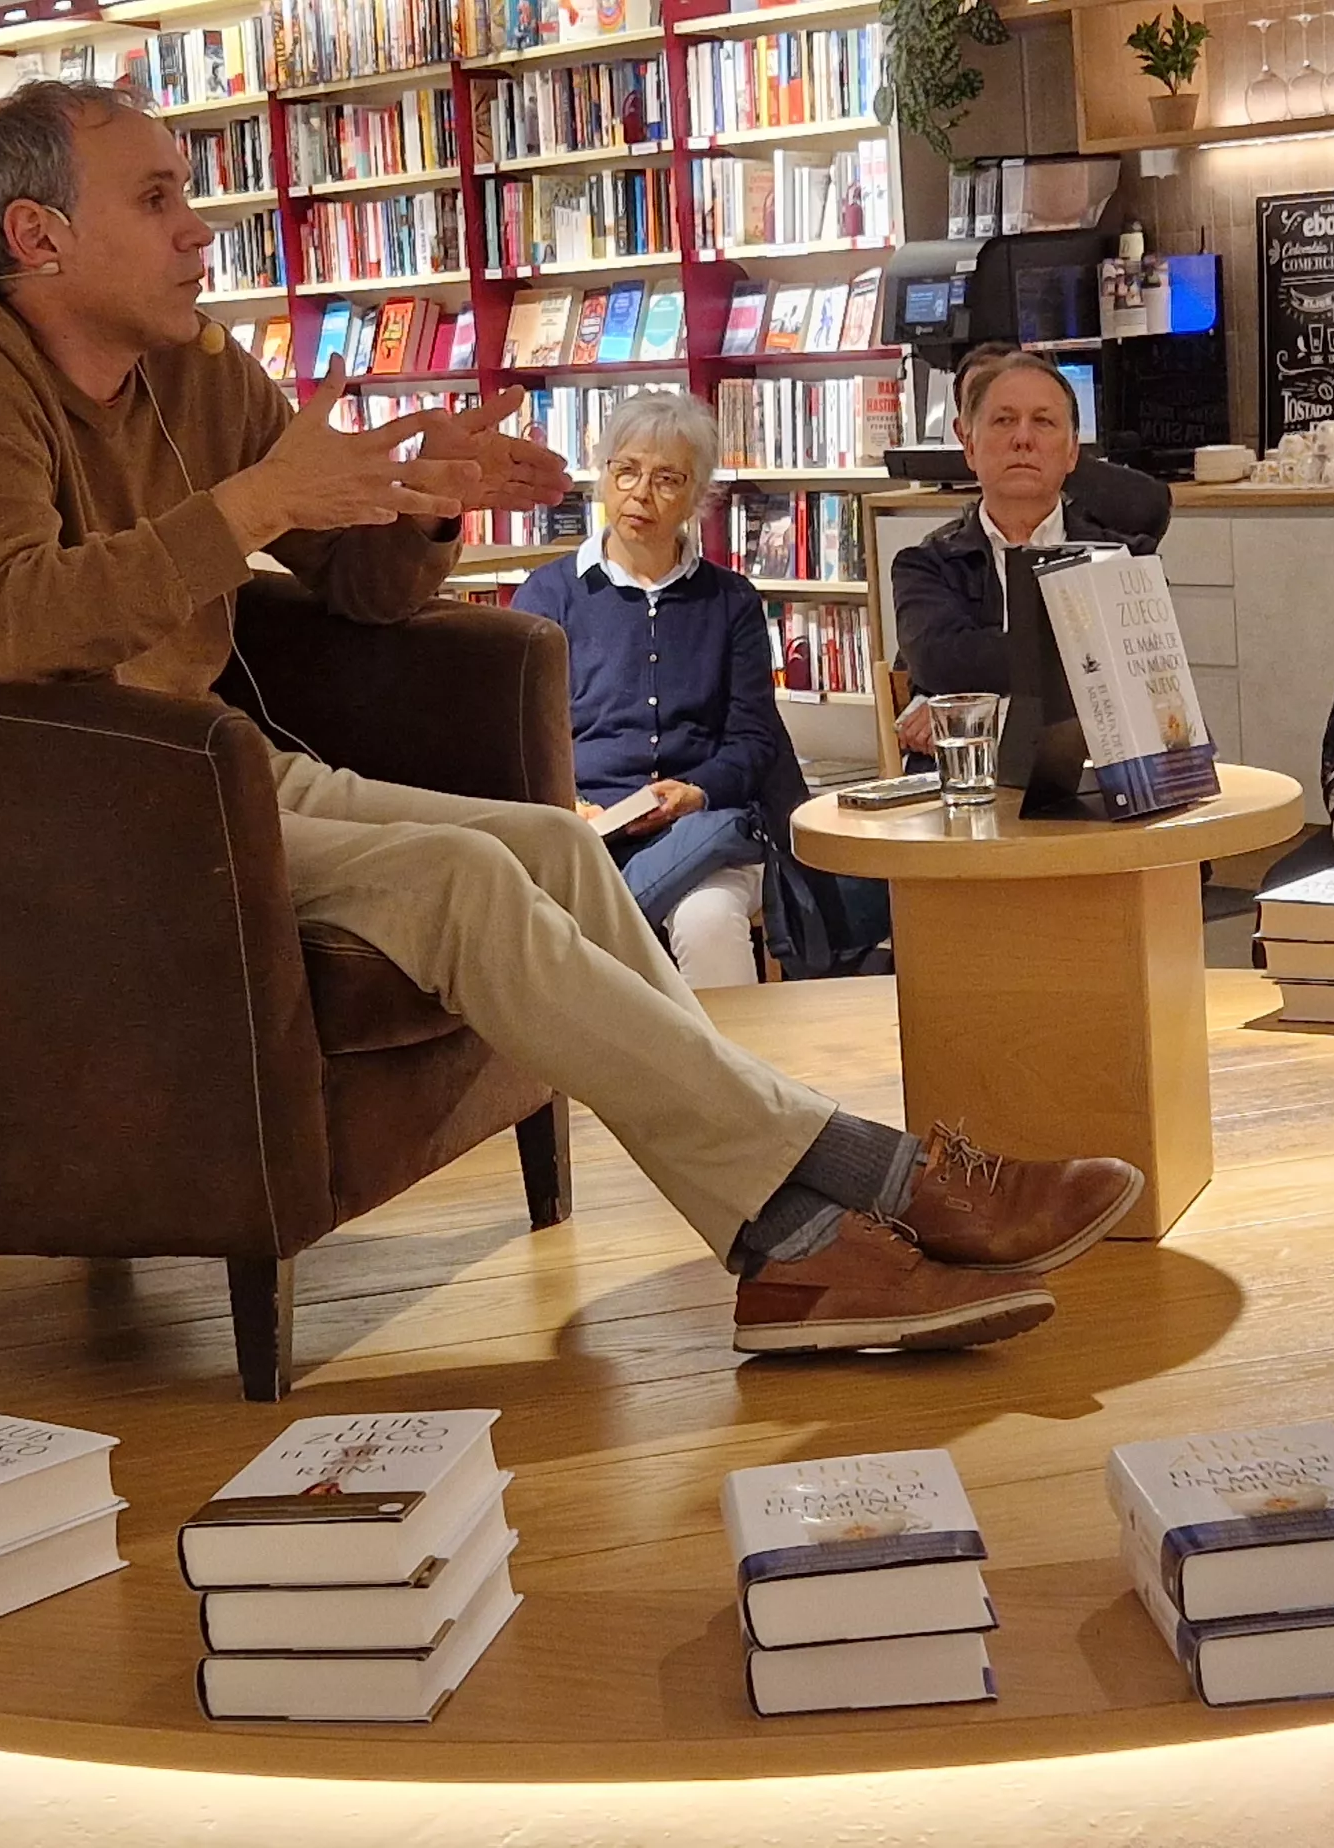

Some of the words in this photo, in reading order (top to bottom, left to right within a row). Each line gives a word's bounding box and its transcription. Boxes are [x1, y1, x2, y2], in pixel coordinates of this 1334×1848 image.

[1281, 391, 1333, 423] TOSTADO
[1119, 567, 1153, 595] LUIS
[1117, 598, 1170, 628] ZUECO
[1123, 637, 1136, 655] EL
[1137, 632, 1165, 653] MAPA
[1167, 632, 1178, 649] DE
[1127, 659, 1146, 677] UN
[1147, 653, 1184, 674] MUNDO
[1145, 675, 1181, 696] NUEVO
[1100, 732, 1115, 763] NUEV
[347, 1416, 435, 1431] LUIS
[303, 1427, 449, 1445] ZUECO
[280, 1450, 307, 1459] EL
[296, 1464, 387, 1476] REINA
[1169, 1470, 1194, 1480] EL
[1207, 1458, 1291, 1477] MAPA
[1299, 1454, 1333, 1466] DE
[1171, 1477, 1217, 1489] UN
[1212, 1476, 1323, 1495] NUEVO
[766, 1497, 794, 1507] EL
[803, 1487, 886, 1505] MAPA
[897, 1482, 927, 1494] DE
[821, 1490, 939, 1512] MUNDO
